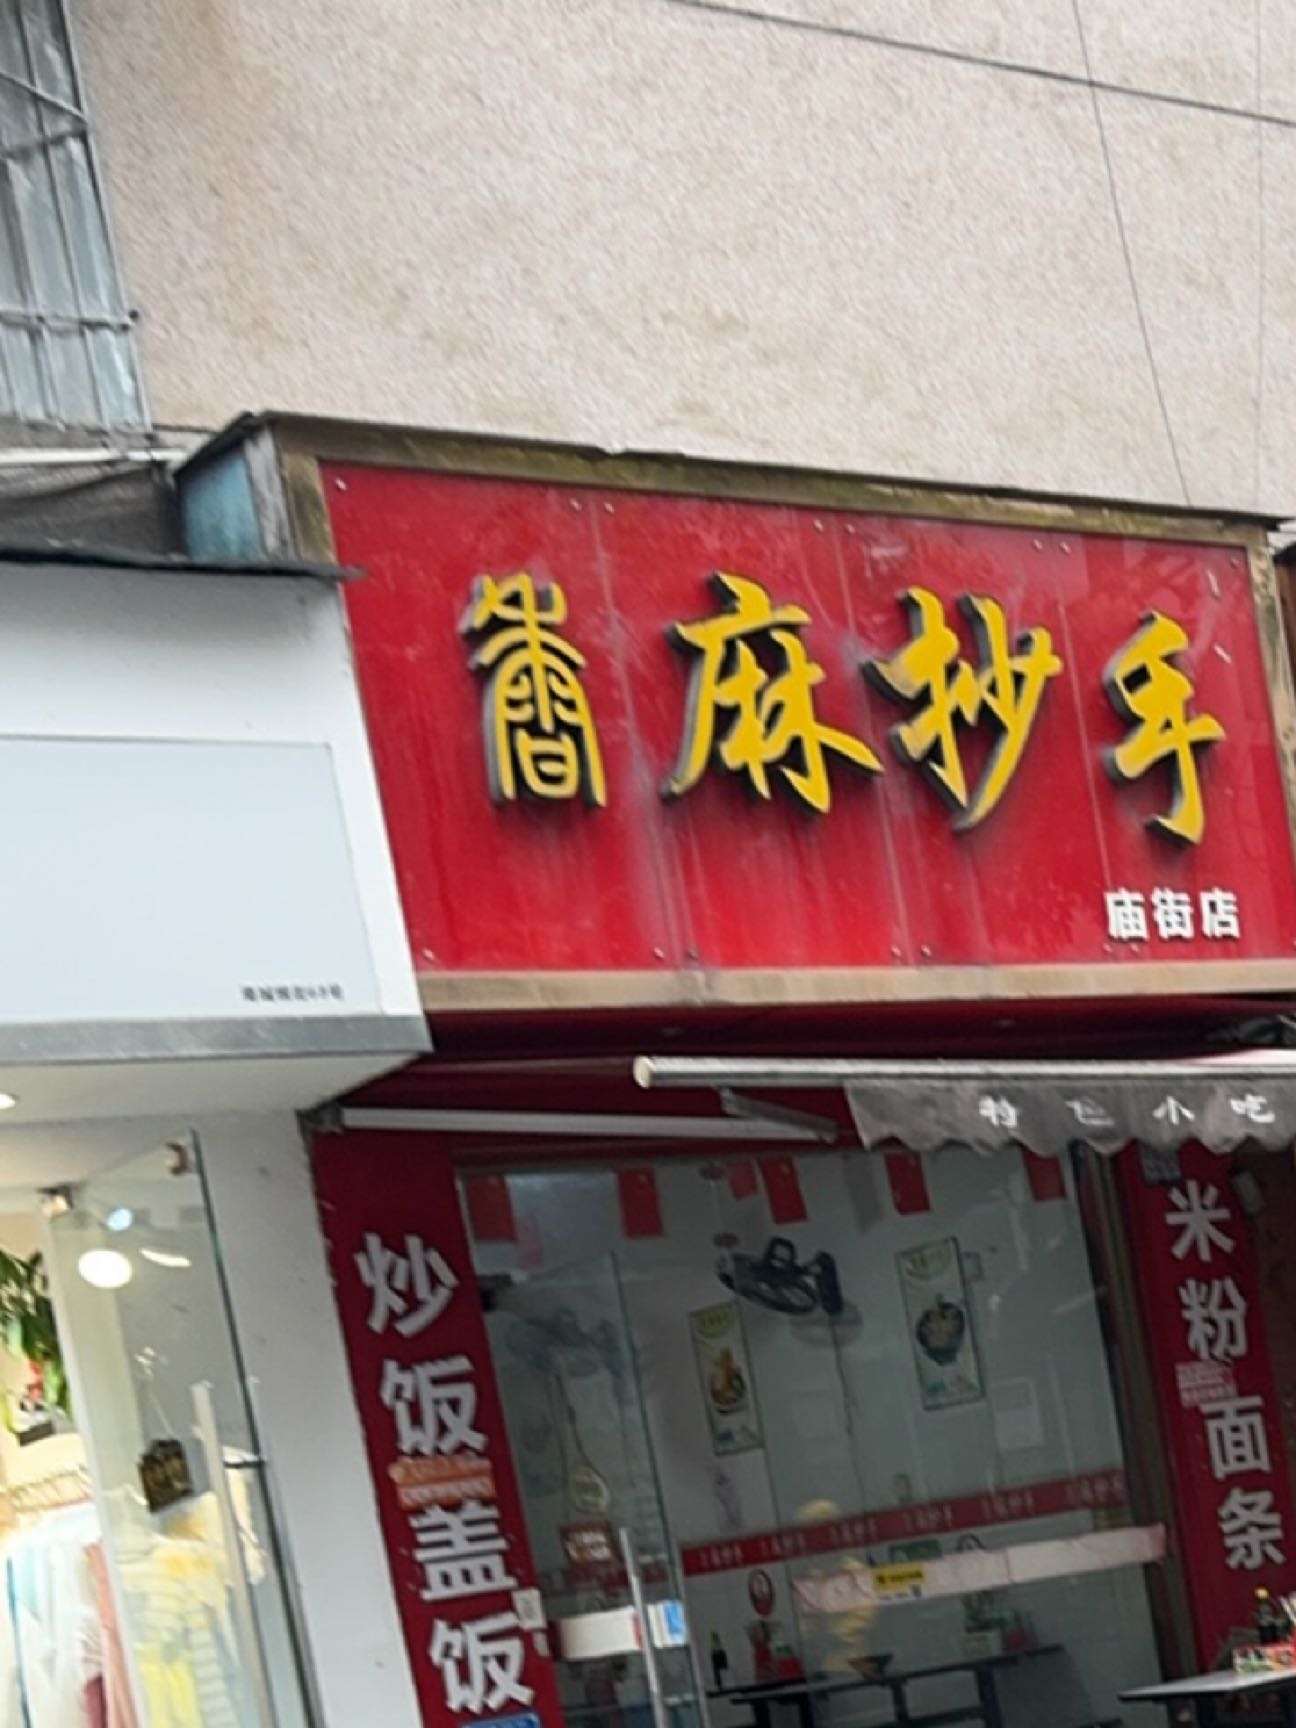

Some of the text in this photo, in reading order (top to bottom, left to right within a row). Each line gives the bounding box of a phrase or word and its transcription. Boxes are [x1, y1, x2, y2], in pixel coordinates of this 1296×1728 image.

[1104, 887, 1243, 942] 庙街店
[353, 1231, 535, 1714] 炒饭盖饭
[1164, 1178, 1288, 1571] 米粉面条
